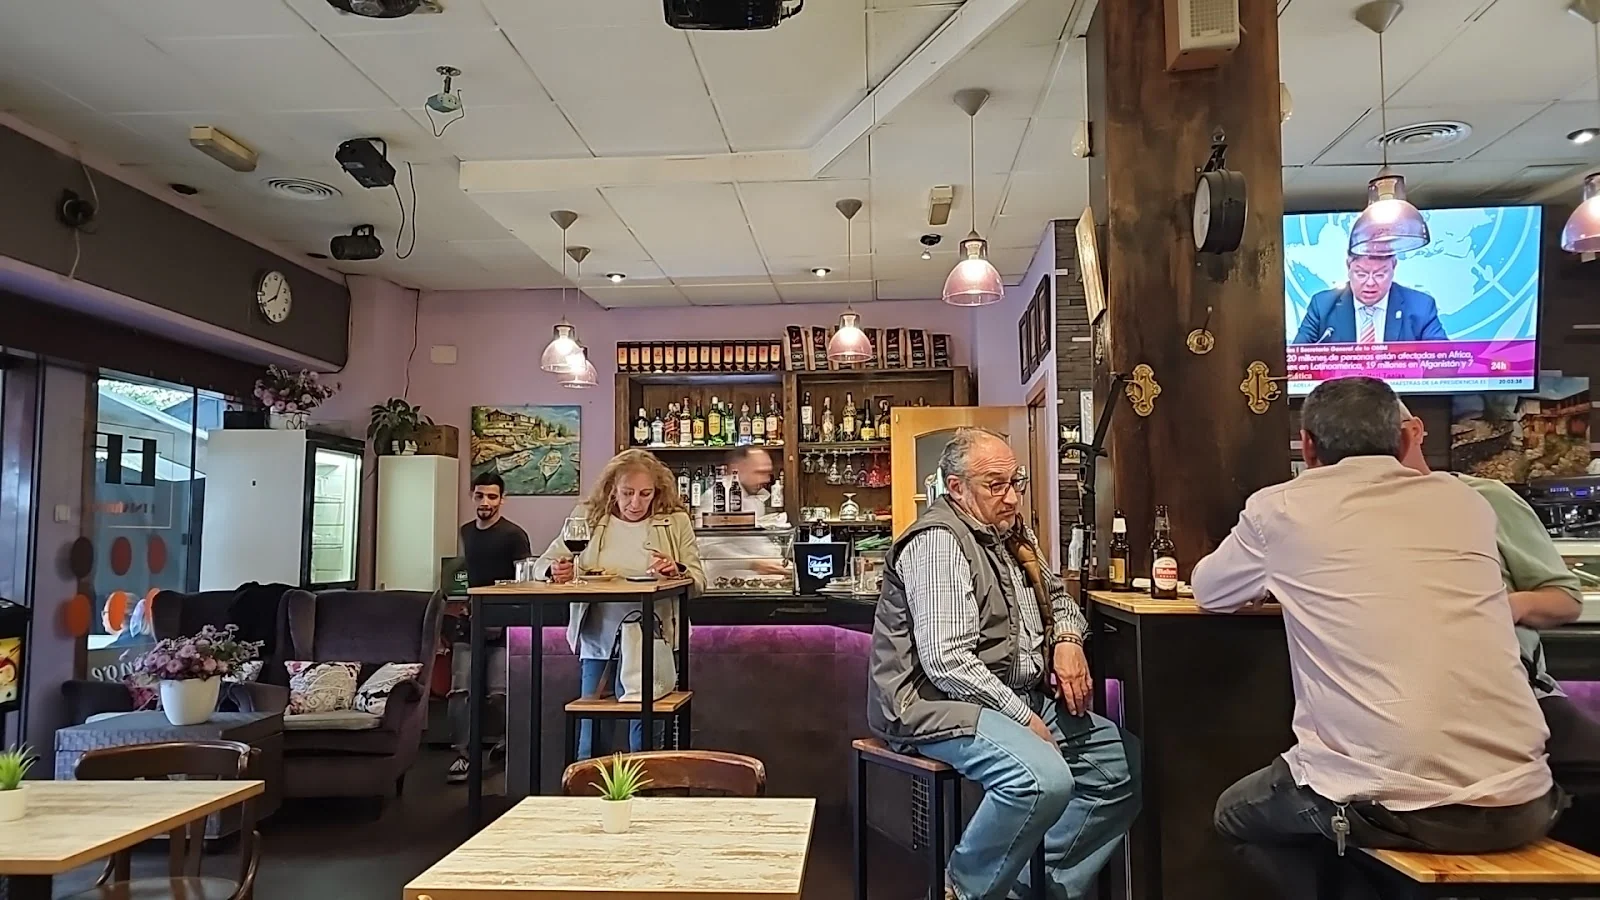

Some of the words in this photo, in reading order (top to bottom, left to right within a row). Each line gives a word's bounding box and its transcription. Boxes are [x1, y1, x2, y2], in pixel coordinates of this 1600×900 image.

[1286, 354, 1297, 362] 20
[1298, 354, 1327, 362] millones
[1340, 354, 1374, 362] personas
[1375, 352, 1396, 360] están
[1398, 351, 1435, 360] afectadas
[1310, 362, 1364, 371] Latinoamérica,
[1365, 361, 1376, 369] 19
[1377, 360, 1407, 369] millones
[1420, 359, 1460, 370] Afganistán
[1461, 361, 1467, 369] y
[1468, 359, 1474, 367] 7
[1490, 361, 1507, 371] 24h
